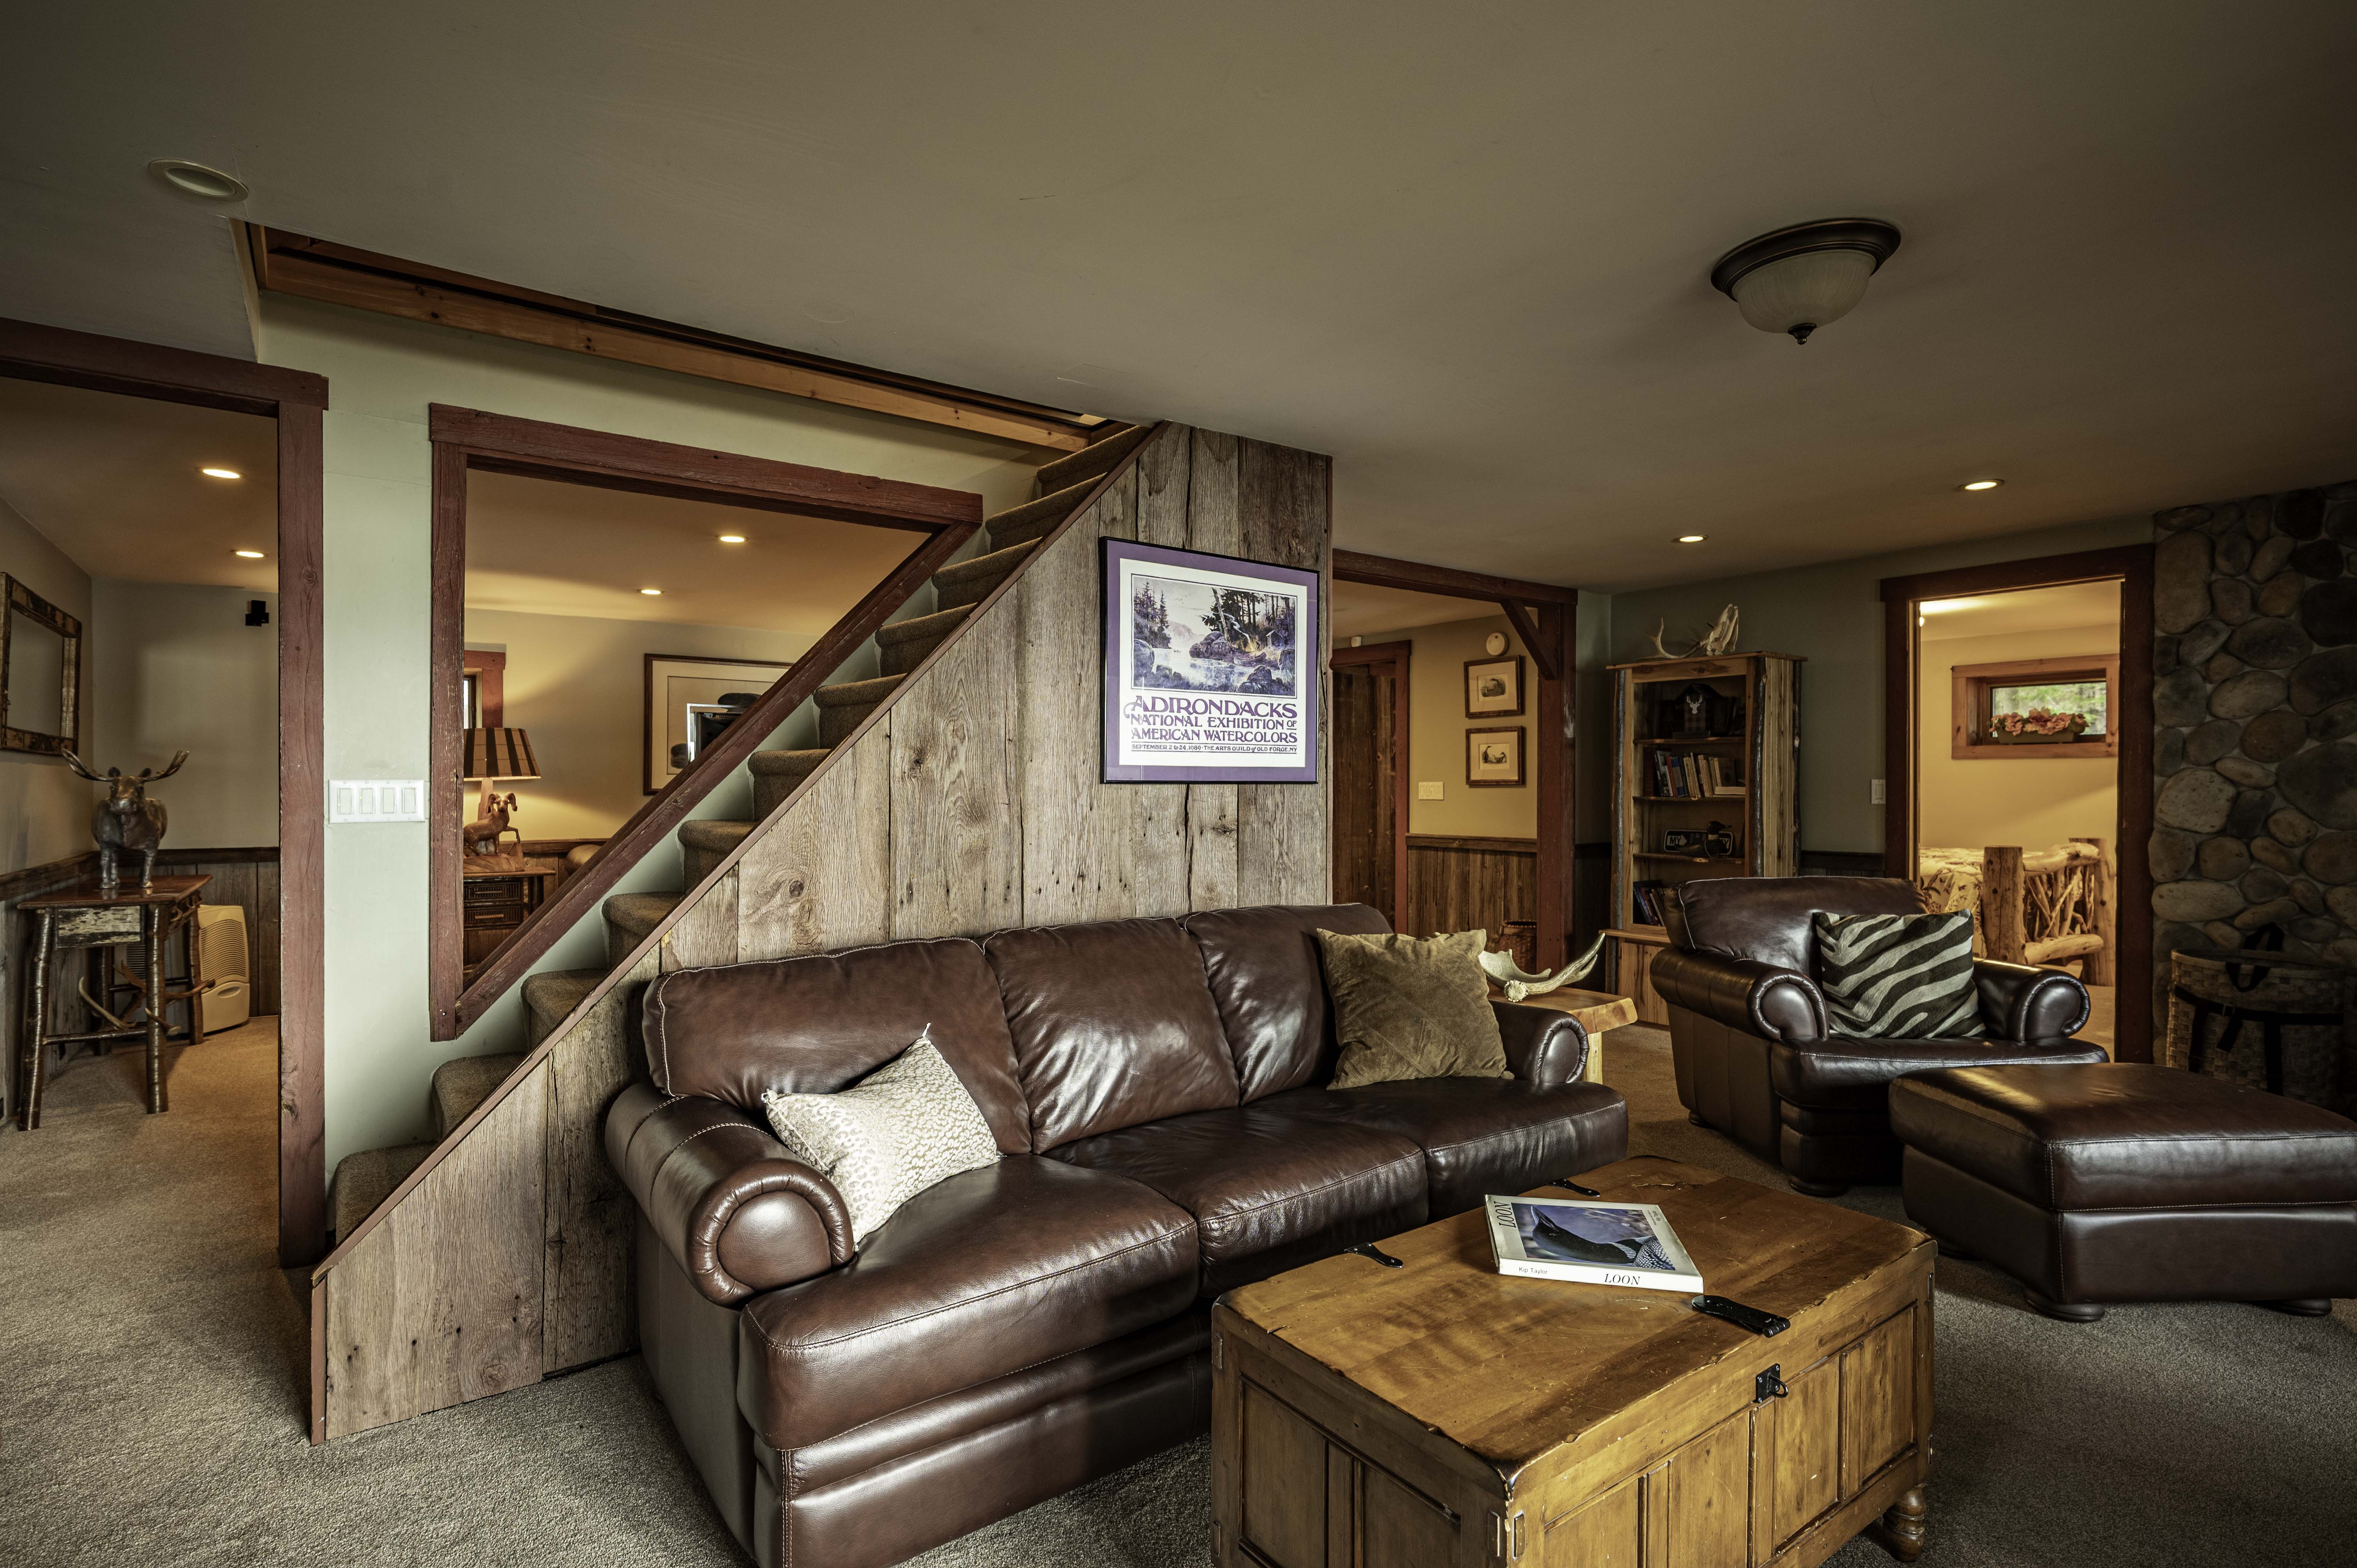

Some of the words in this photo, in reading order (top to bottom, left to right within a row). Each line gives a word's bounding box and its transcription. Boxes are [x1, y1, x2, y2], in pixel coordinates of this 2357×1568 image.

[1124, 696, 1297, 718] ADIRONDACKS
[1131, 714, 1202, 727] NATIONAL
[1207, 717, 1284, 730] EXHIBITION
[1131, 727, 1200, 741] AMERICAN
[1203, 730, 1297, 743] WATERCOLORS
[1670, 837, 1681, 845] MY
[1494, 1201, 1516, 1228] LOON
[1604, 1274, 1640, 1285] LOON
